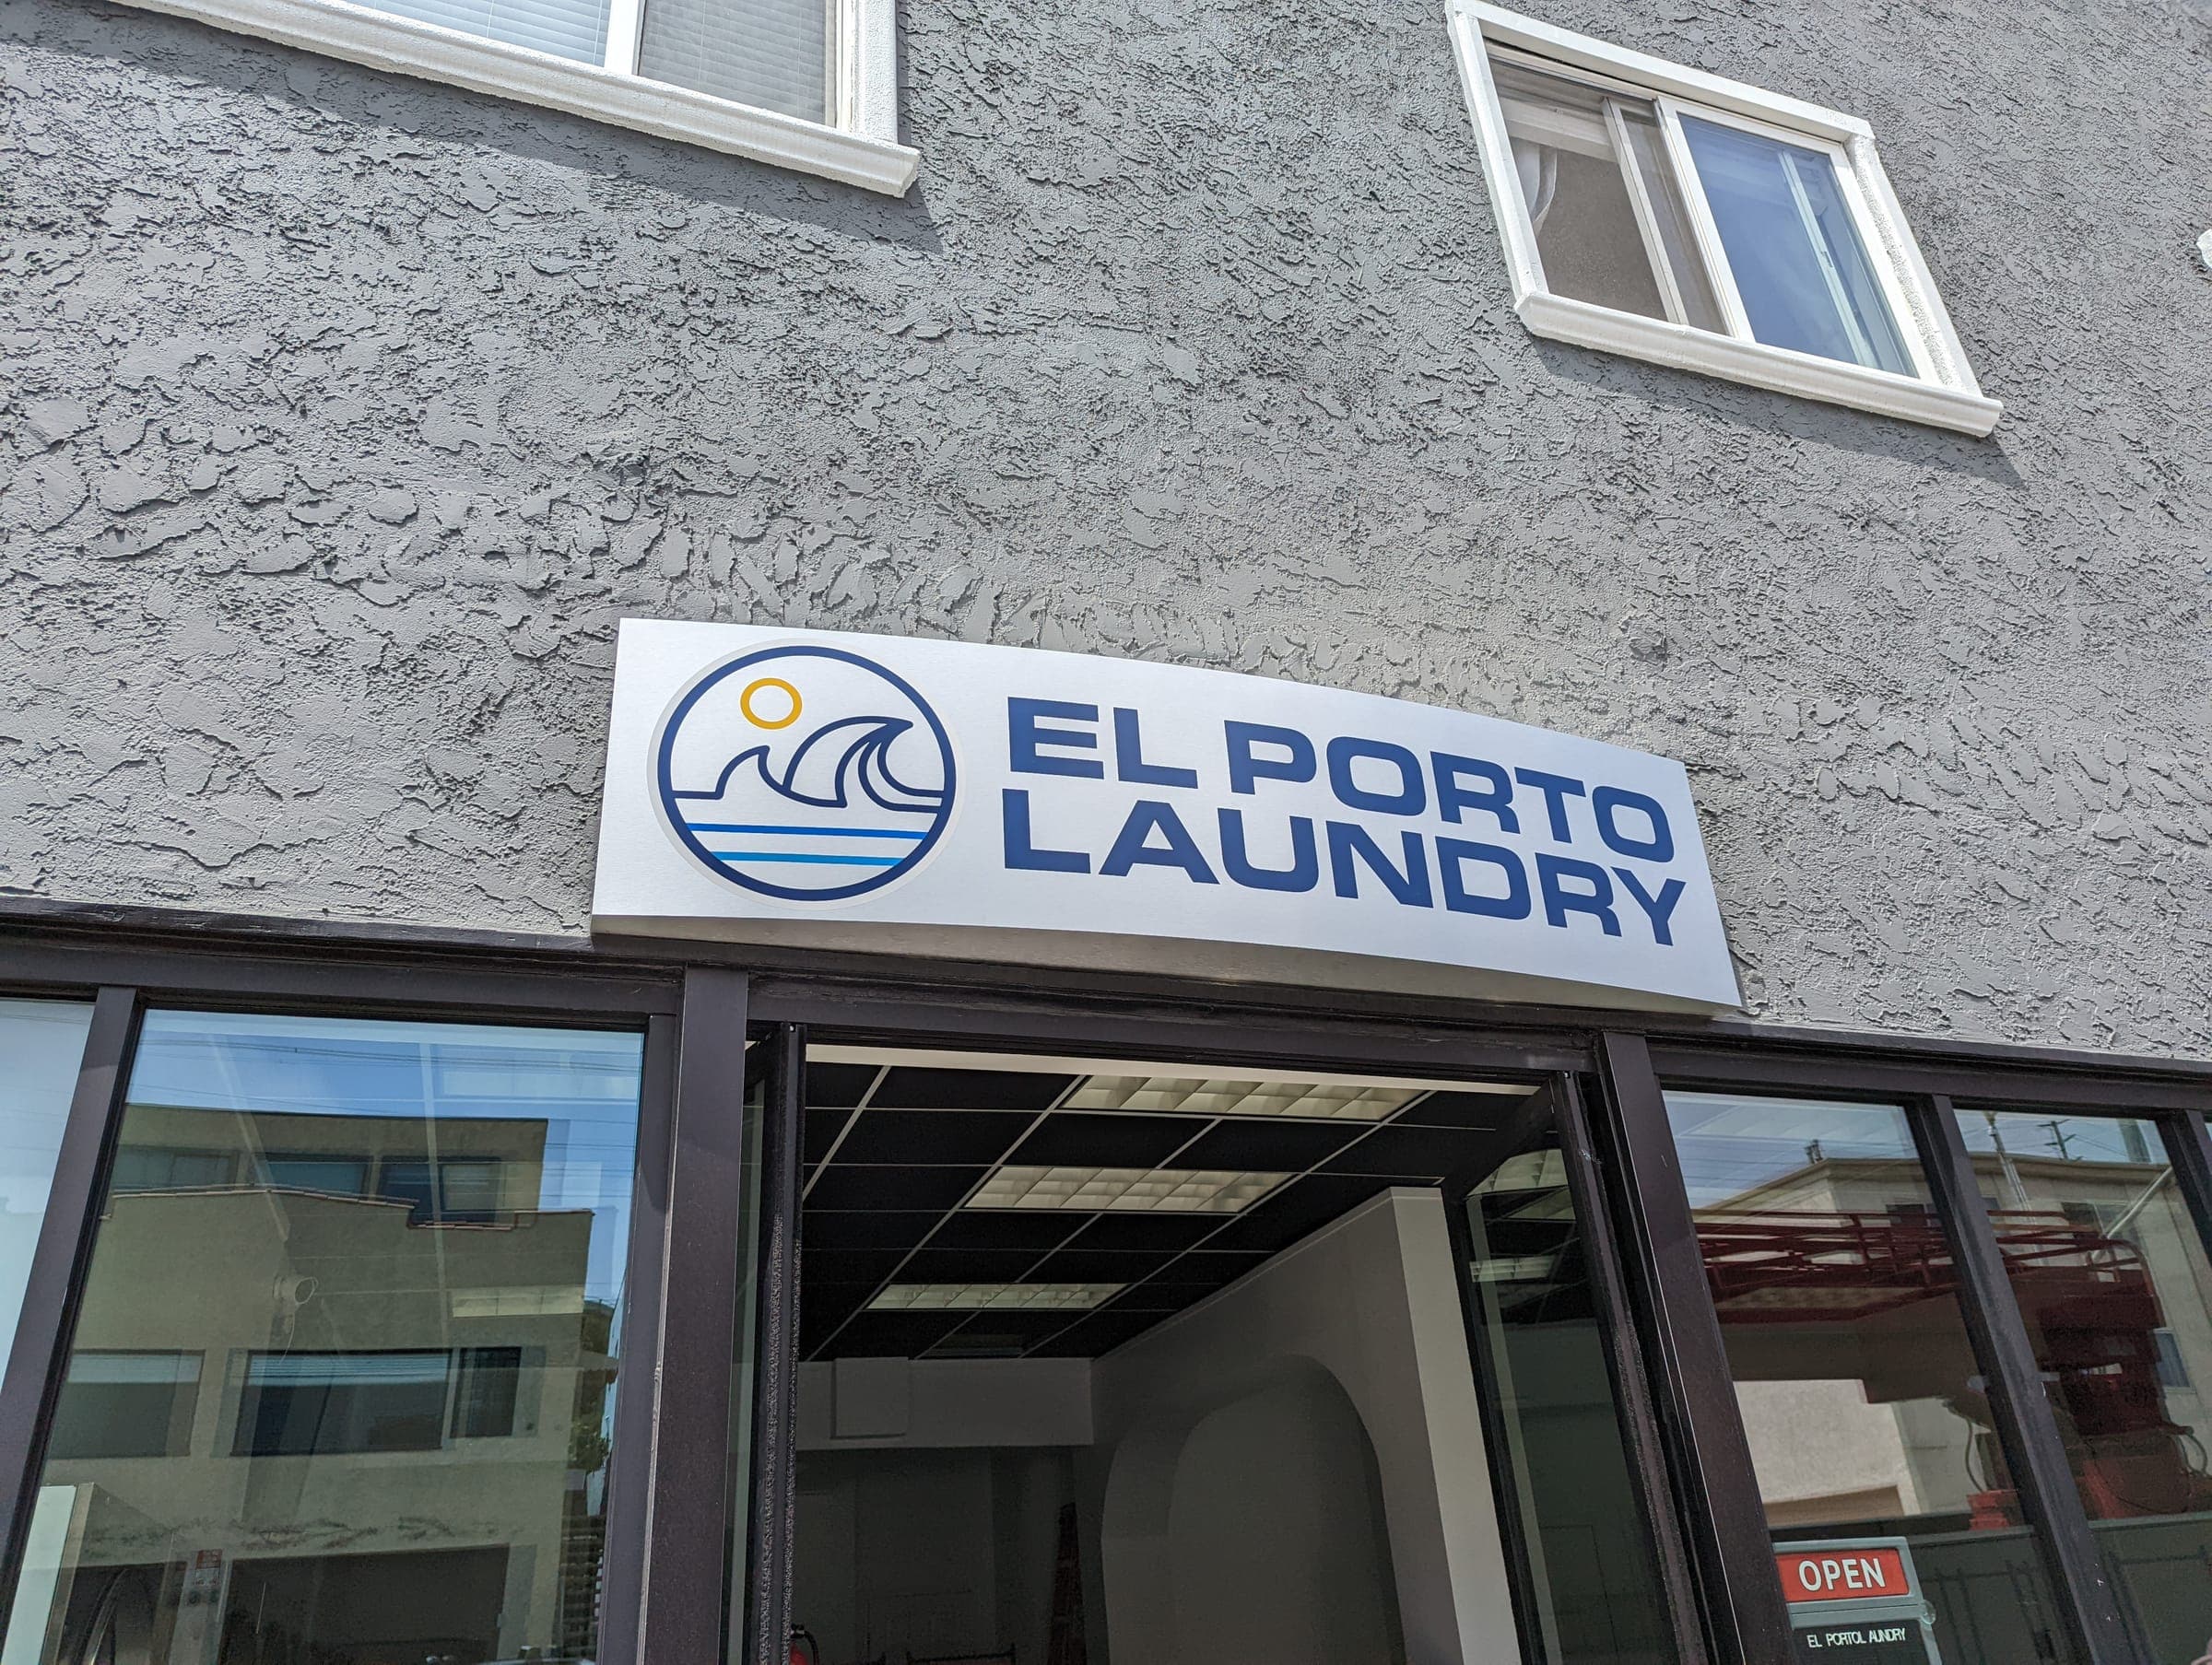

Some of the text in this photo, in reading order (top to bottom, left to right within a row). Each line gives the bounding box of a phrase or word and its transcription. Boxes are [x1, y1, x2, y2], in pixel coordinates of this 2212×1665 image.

[1007, 697, 1675, 863] EL PORTO
[1002, 788, 1687, 947] LAUNDRY
[1798, 1557, 1886, 1591] OPEN
[1806, 1634, 1823, 1648] EL
